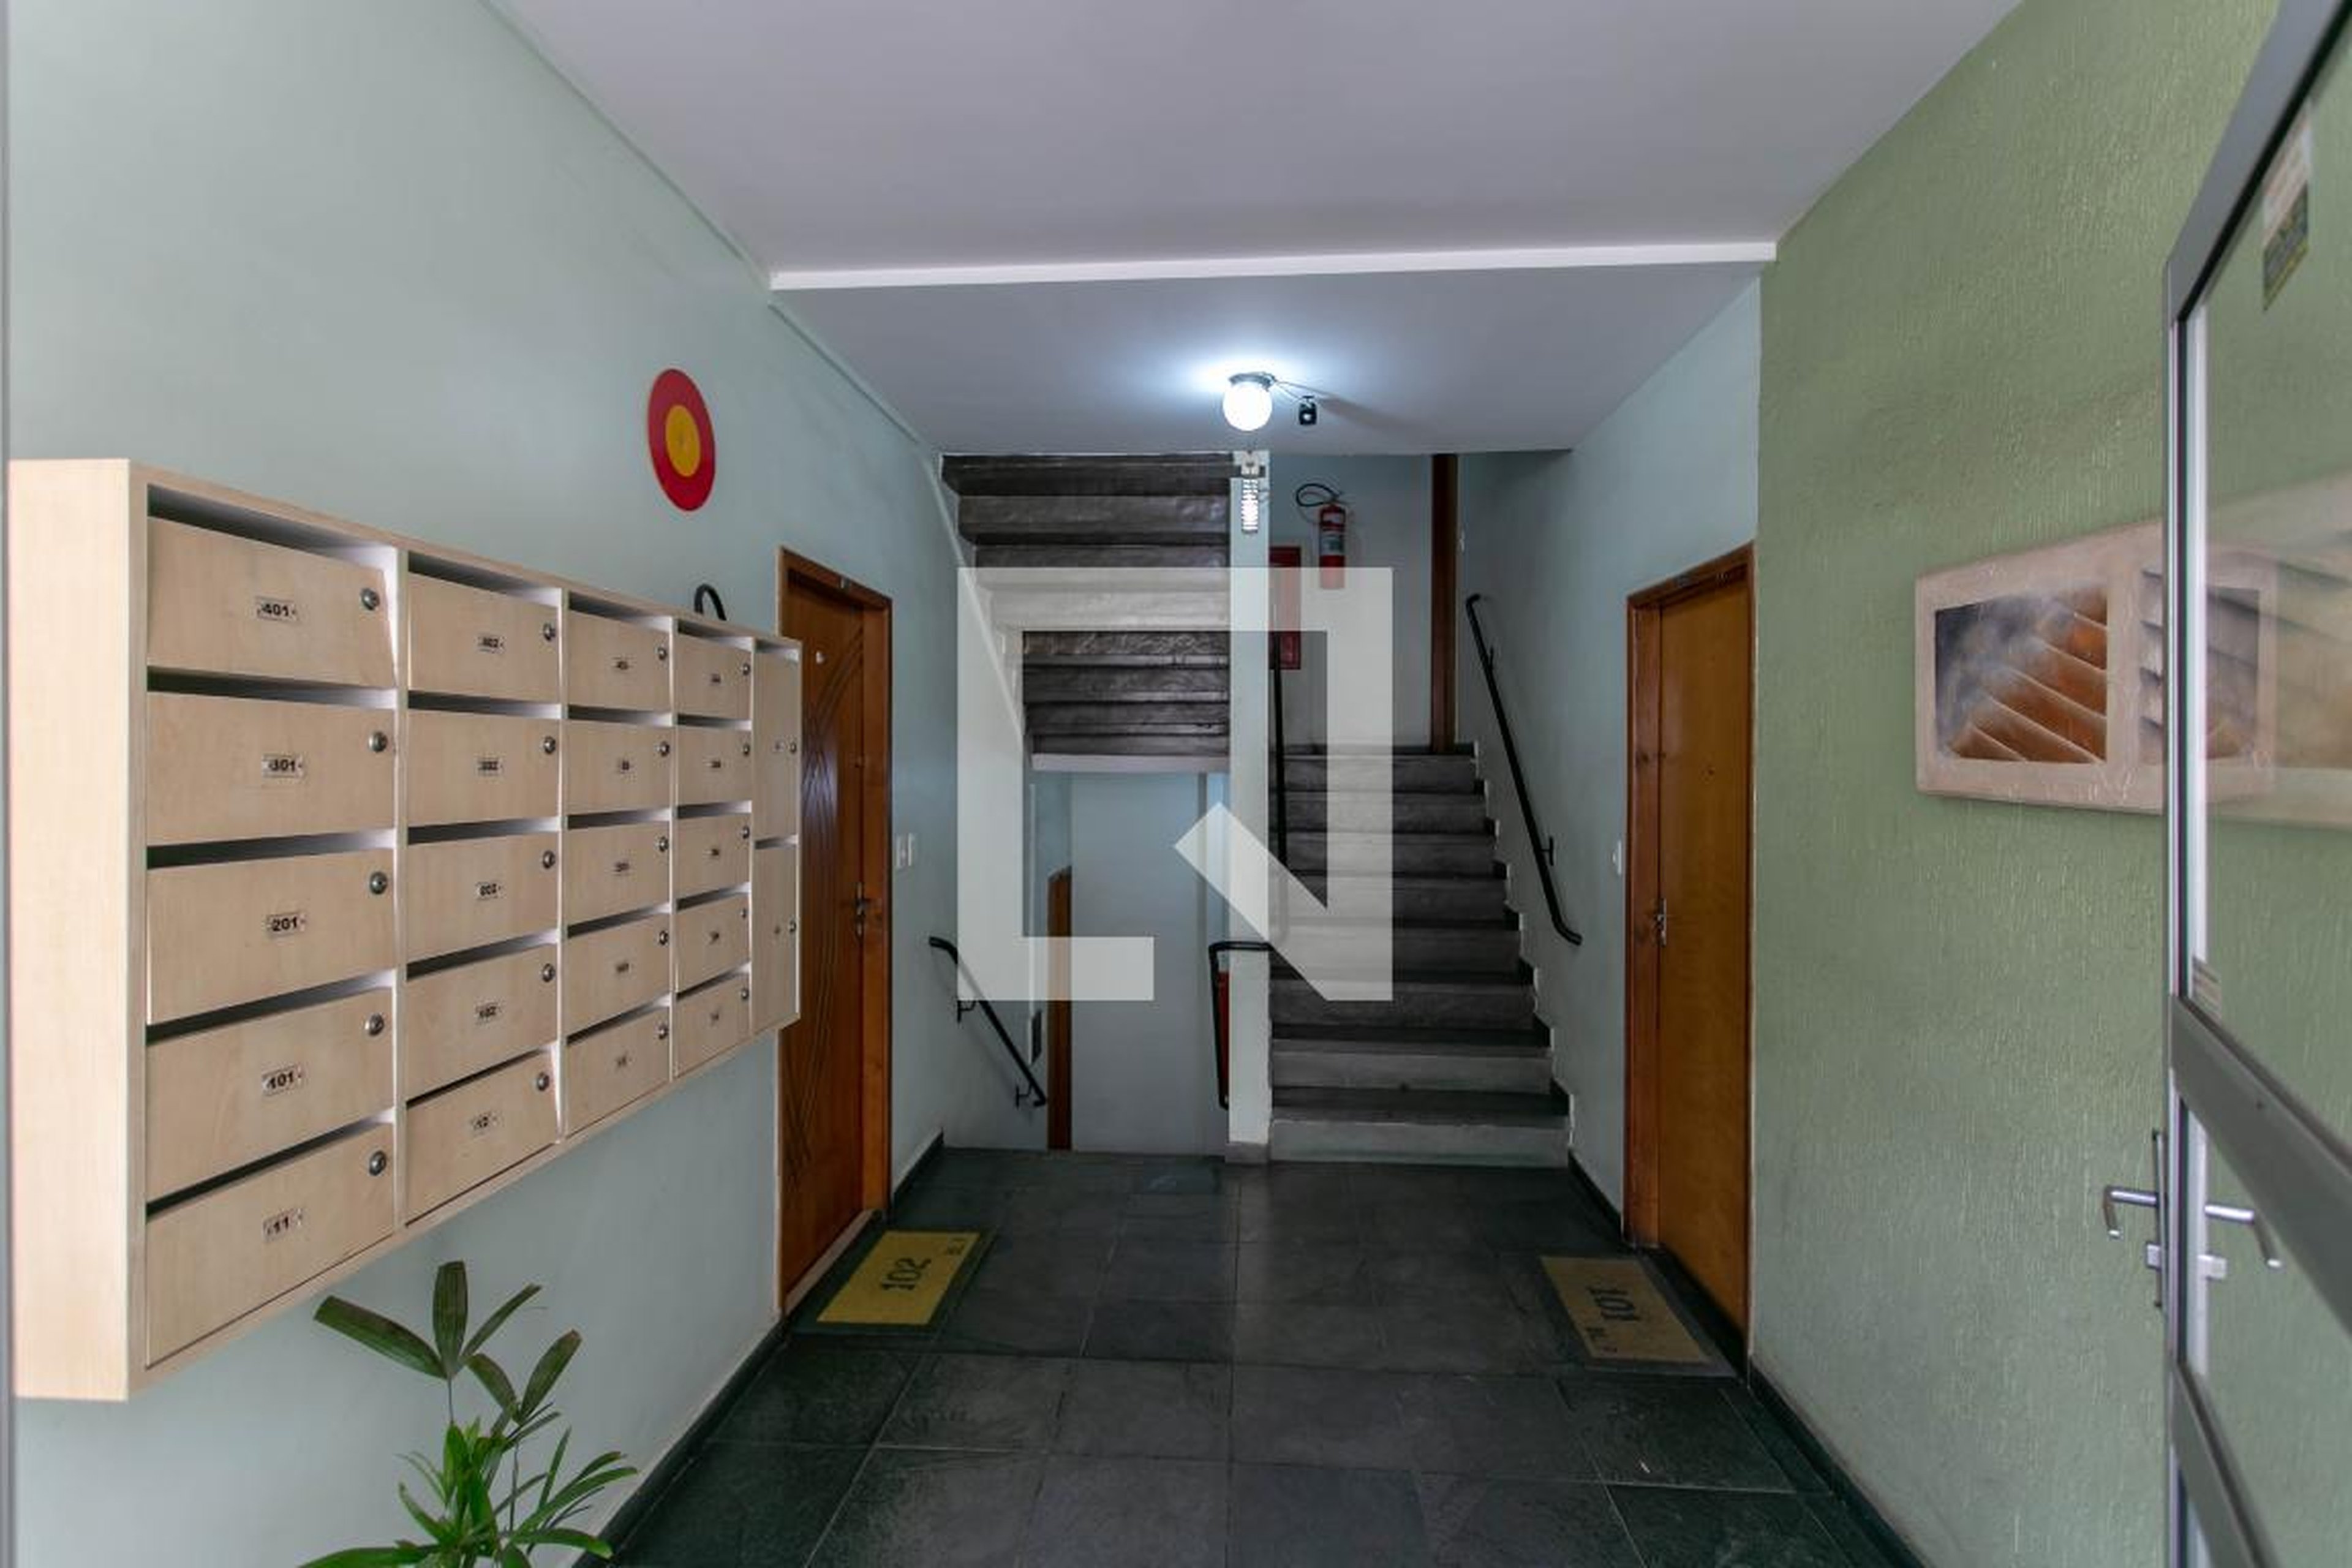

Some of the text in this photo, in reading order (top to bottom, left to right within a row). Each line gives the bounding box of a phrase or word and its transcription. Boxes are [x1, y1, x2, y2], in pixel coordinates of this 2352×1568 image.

[262, 603, 289, 617] 401
[268, 759, 295, 772] 301
[271, 916, 298, 932] 201
[267, 1070, 294, 1089] 101
[273, 1216, 289, 1234] 11
[881, 1257, 932, 1291] 102
[1588, 1287, 1641, 1322] 101
